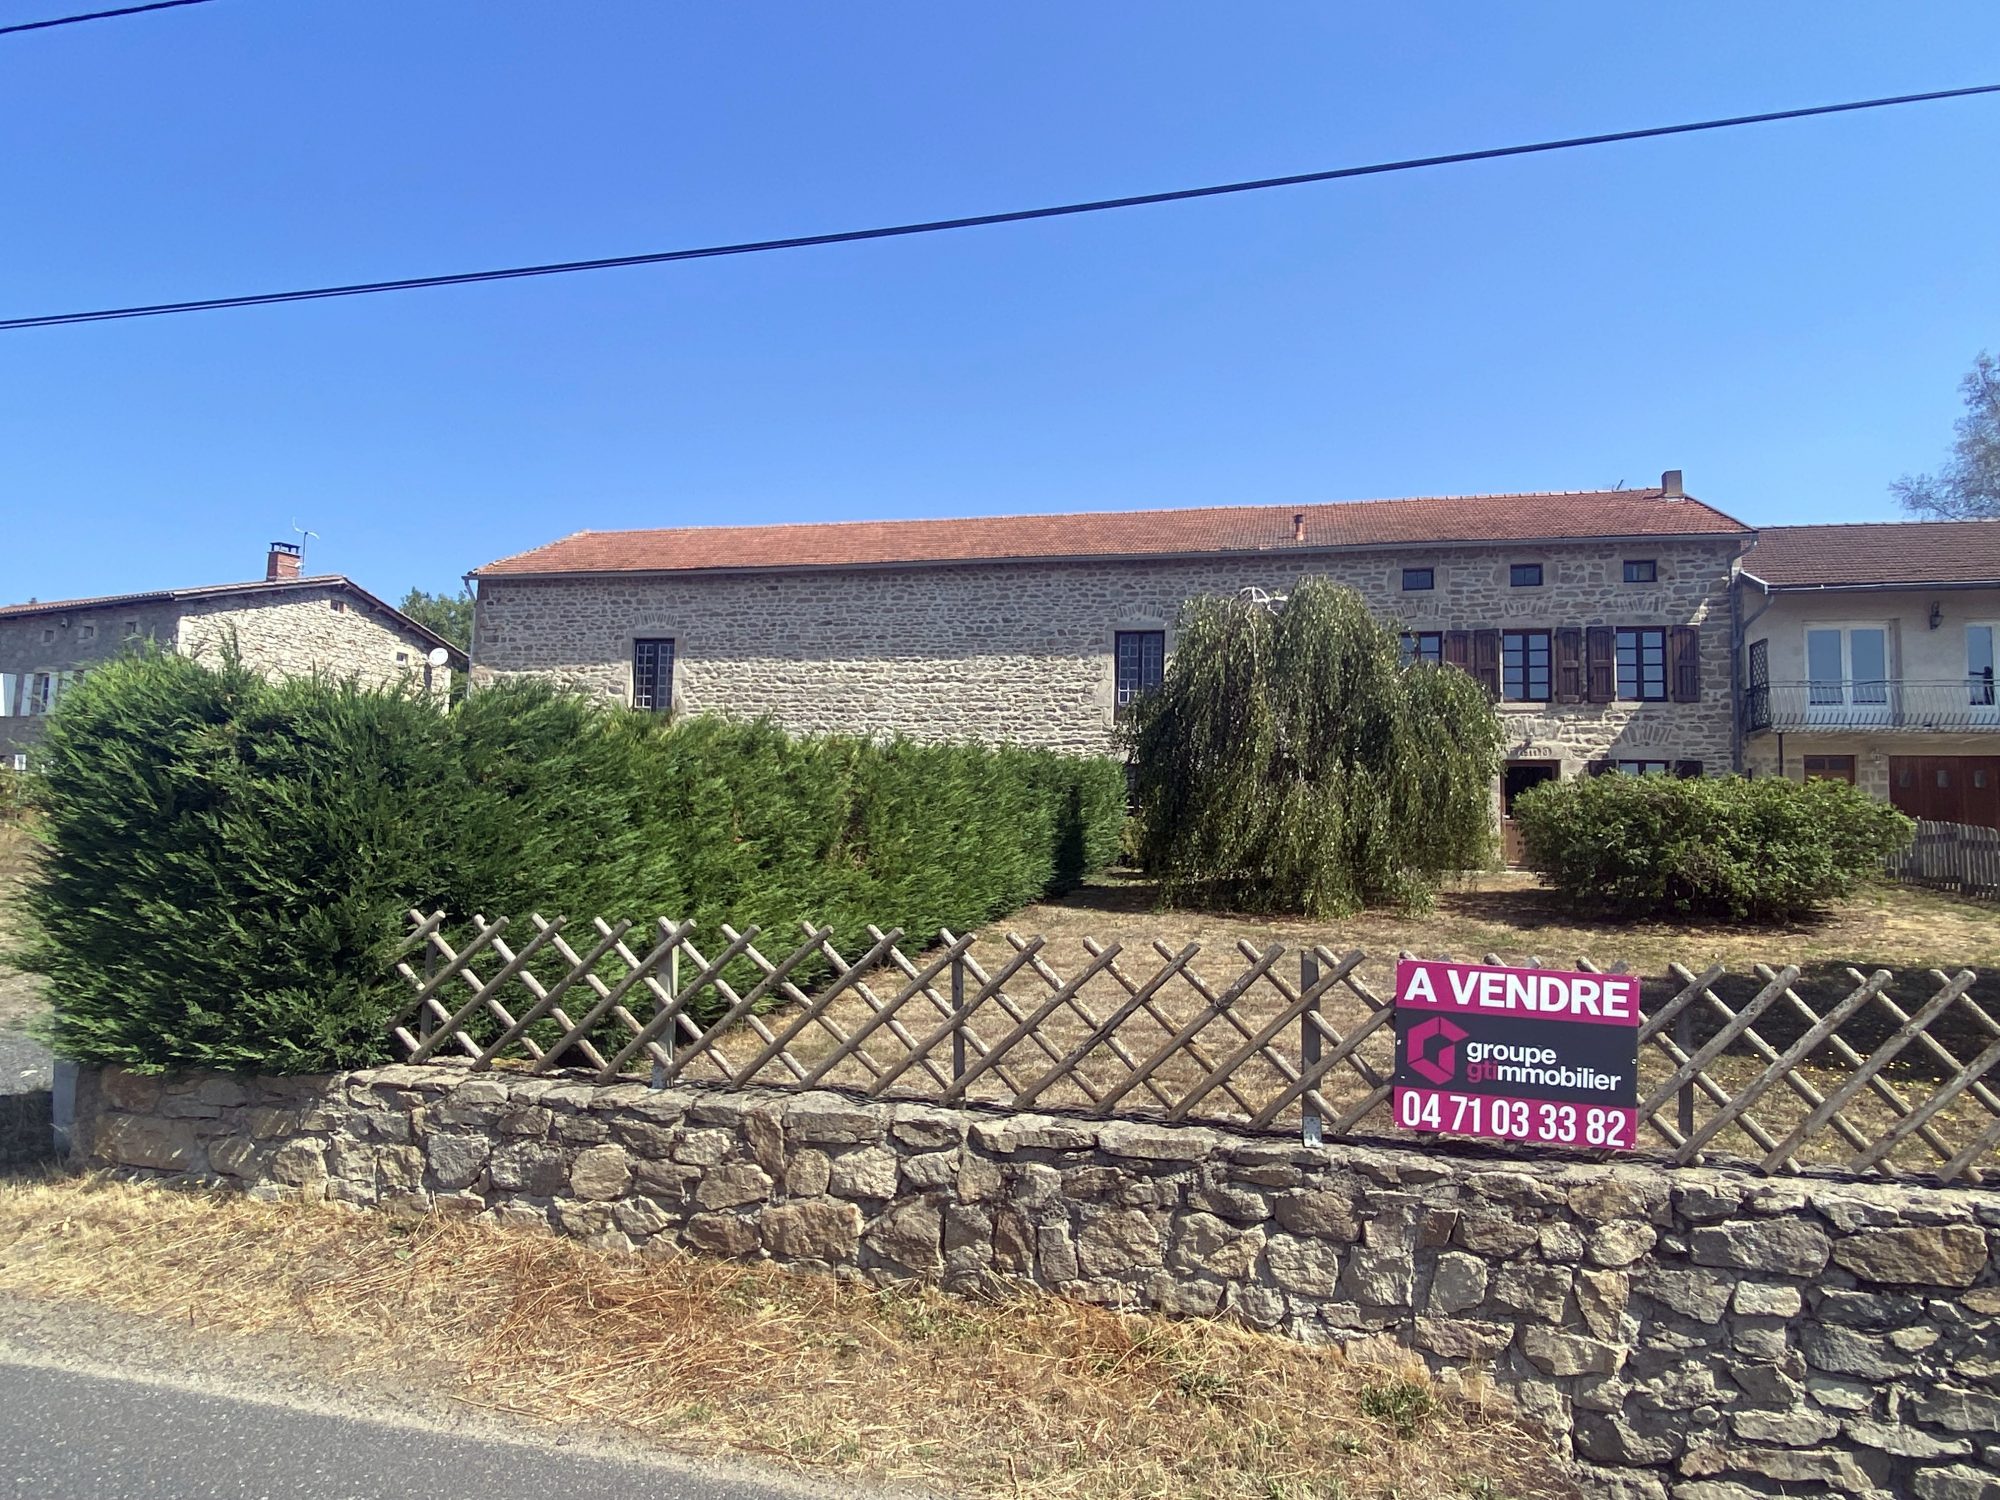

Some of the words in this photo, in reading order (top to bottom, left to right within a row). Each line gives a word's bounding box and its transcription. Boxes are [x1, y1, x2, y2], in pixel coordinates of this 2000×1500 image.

[1404, 967, 1438, 1003] A
[1447, 970, 1630, 1018] VENDRE
[1466, 1041, 1557, 1068] groupe
[1466, 1060, 1622, 1092] gtimmobilier
[1402, 1091, 1442, 1129] 04
[1449, 1095, 1481, 1133] 71
[1491, 1099, 1530, 1138] 03
[1539, 1103, 1577, 1142] 33
[1586, 1108, 1626, 1147] 82
